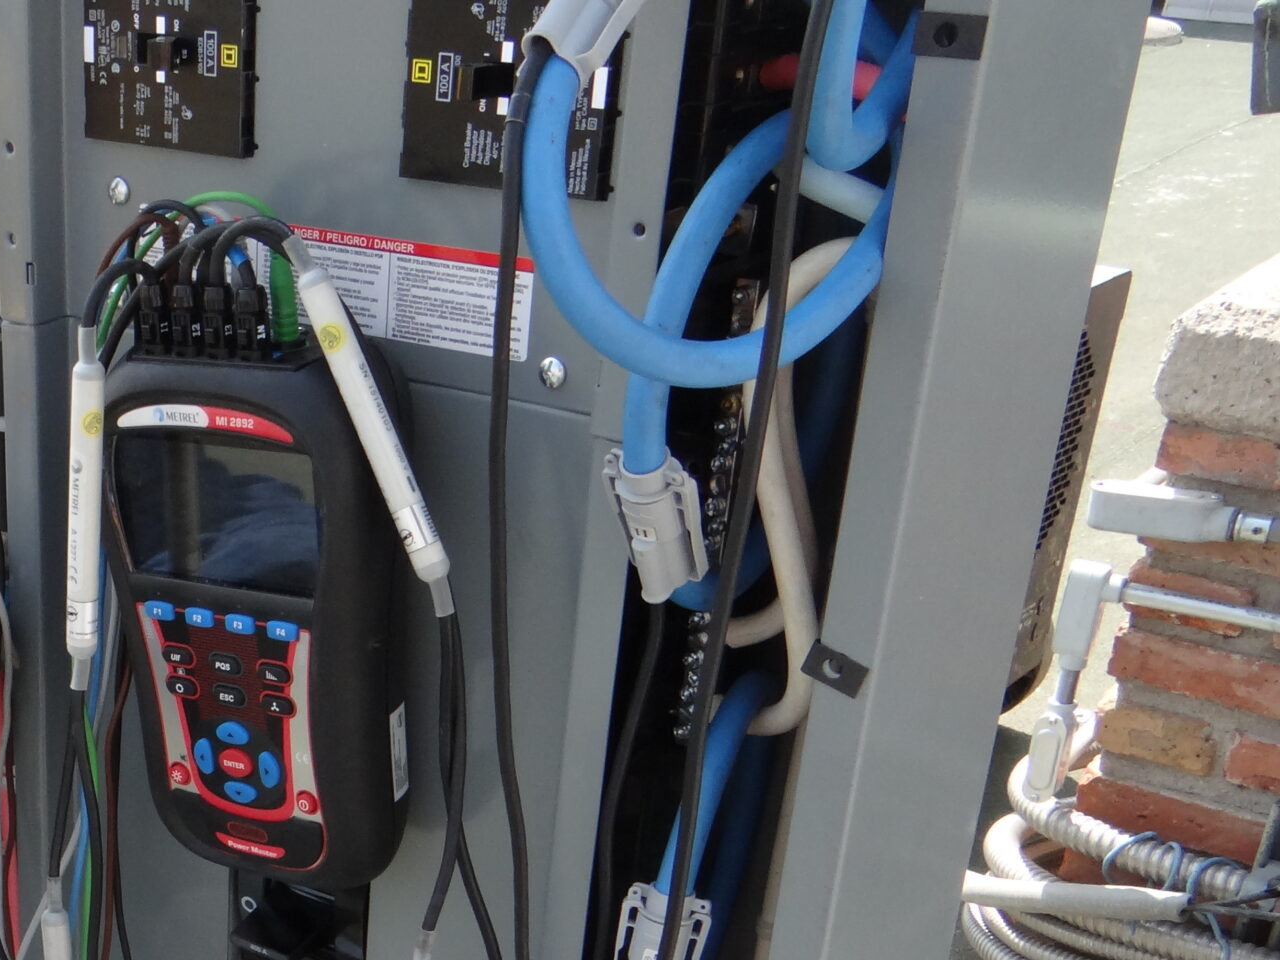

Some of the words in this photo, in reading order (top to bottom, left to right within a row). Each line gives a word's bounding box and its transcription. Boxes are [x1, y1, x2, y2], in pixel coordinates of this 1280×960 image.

[173, 19, 180, 32] ON
[206, 38, 214, 57] 100
[206, 58, 214, 68] A
[440, 62, 450, 72] A
[439, 74, 448, 94] 100
[478, 98, 486, 112] ON
[326, 232, 367, 247] PELIGRO
[374, 239, 415, 253] DANGER
[215, 415, 228, 427] MI
[229, 417, 254, 429] 2892
[153, 608, 162, 616] F1
[192, 614, 202, 623] F2
[233, 620, 243, 630] F3
[275, 627, 286, 637] F4
[215, 661, 231, 671] PQS
[219, 692, 234, 703] ESC
[223, 759, 245, 770] ENTER
